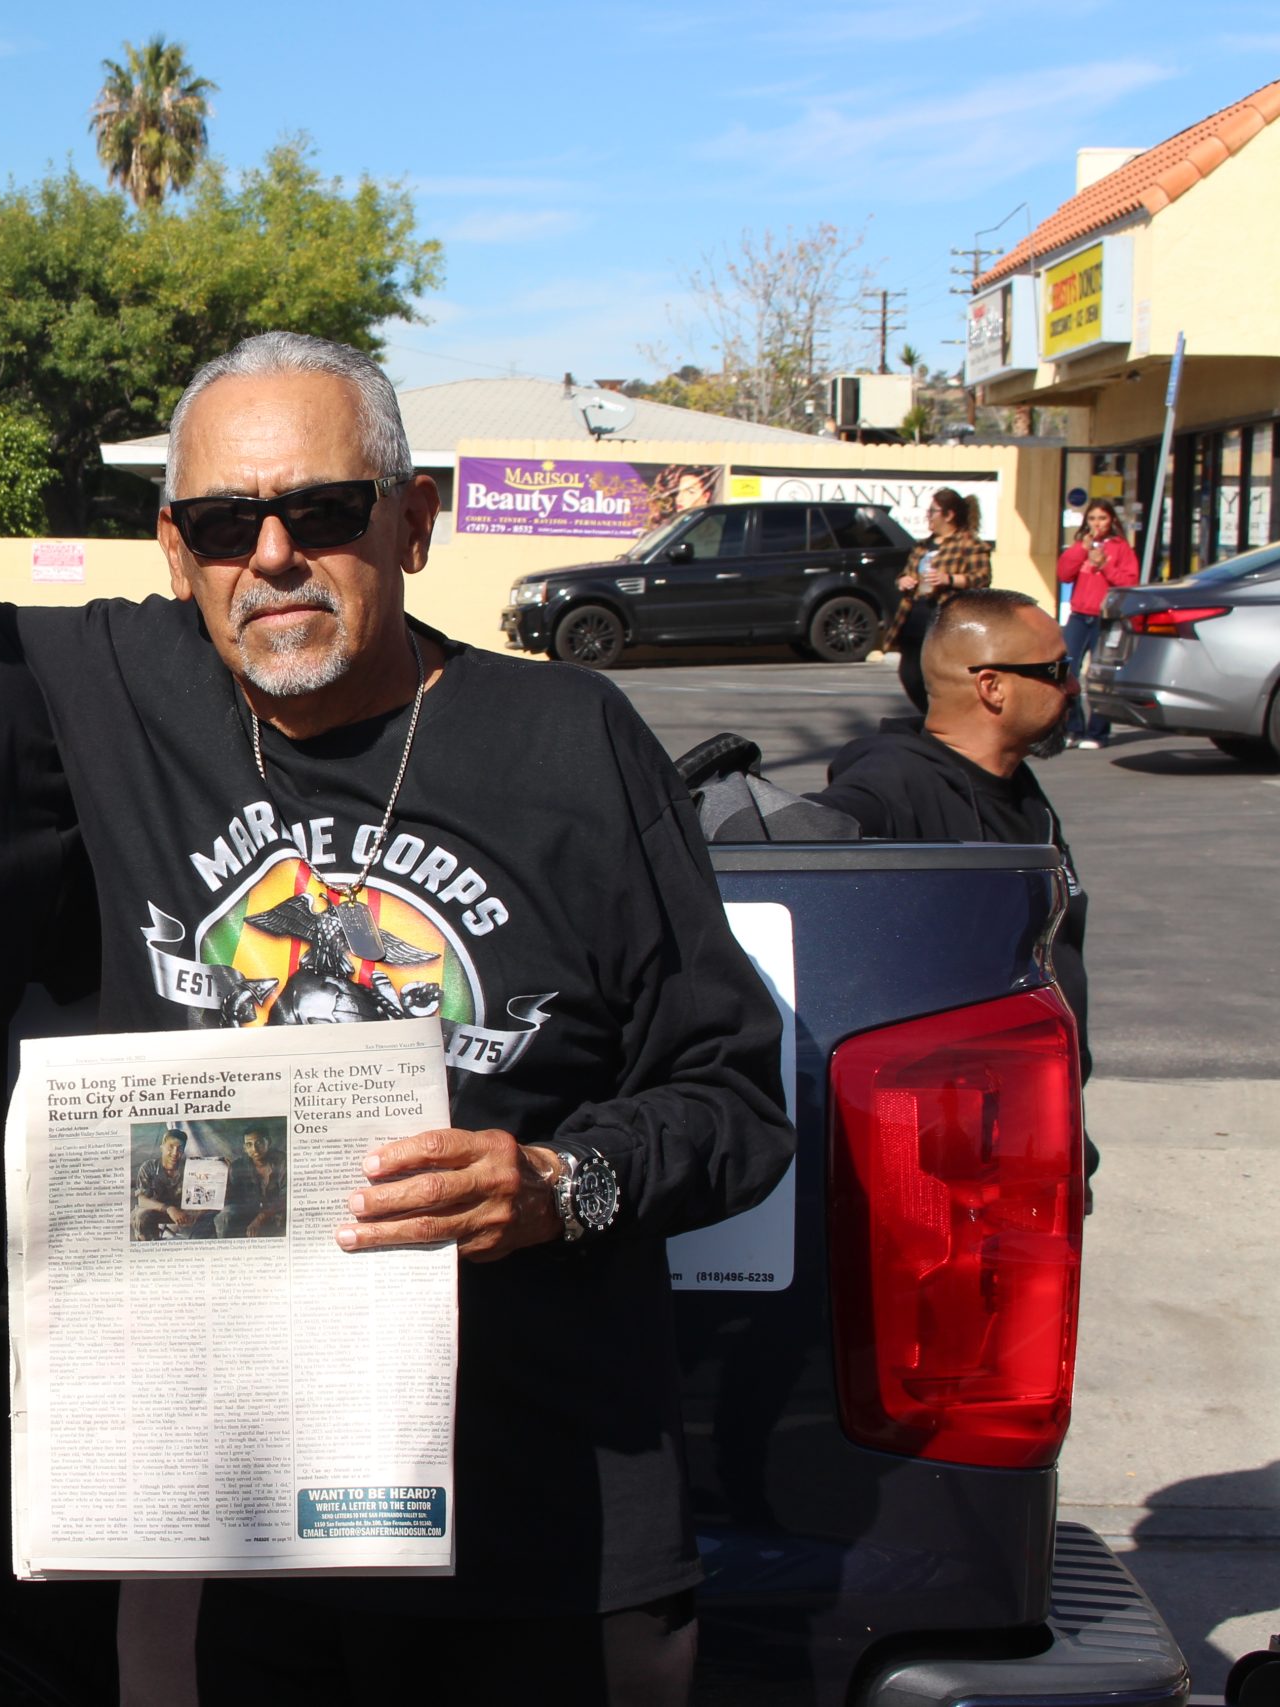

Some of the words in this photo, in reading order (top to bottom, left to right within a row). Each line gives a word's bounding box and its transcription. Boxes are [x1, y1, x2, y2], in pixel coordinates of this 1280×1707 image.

[466, 483, 557, 518] Beauty
[562, 489, 631, 515] Salon
[351, 824, 510, 937] CORPS
[443, 1031, 504, 1063] 1775
[294, 1068, 319, 1079] Ask
[324, 1067, 344, 1078] the
[349, 1064, 382, 1076] DMV
[398, 1063, 426, 1076] Tips
[47, 1079, 76, 1091] Two
[81, 1077, 116, 1092] Long
[121, 1075, 156, 1087] Time
[162, 1070, 282, 1086] Friends-Veterans
[294, 1082, 312, 1093] for
[317, 1079, 395, 1092] Active-Duty
[48, 1094, 81, 1106] from
[86, 1092, 115, 1108] City
[120, 1091, 136, 1103] of
[139, 1091, 164, 1102] San
[170, 1086, 236, 1100] Fernando
[294, 1096, 346, 1108] Military
[352, 1090, 418, 1104] Personnel,
[49, 1109, 97, 1121] Return
[103, 1107, 123, 1119] for
[129, 1104, 179, 1117] Annual
[184, 1101, 231, 1114] Parade
[294, 1110, 351, 1120] Veterans
[356, 1106, 380, 1118] and
[385, 1104, 423, 1116] Loved
[294, 1124, 328, 1134] Ones
[696, 1272, 774, 1284] (818)495-5239
[309, 1490, 344, 1501] WANT
[347, 1489, 362, 1499] TO
[369, 1489, 385, 1499] BE
[390, 1488, 437, 1499] HEARD?
[316, 1503, 340, 1511] WRITE
[349, 1502, 376, 1511] LETTER
[407, 1501, 431, 1510] EDITOR
[303, 1529, 327, 1537] EMAIL:
[329, 1527, 441, 1536] EDITOR@SANFERNANDOSUN.COM
